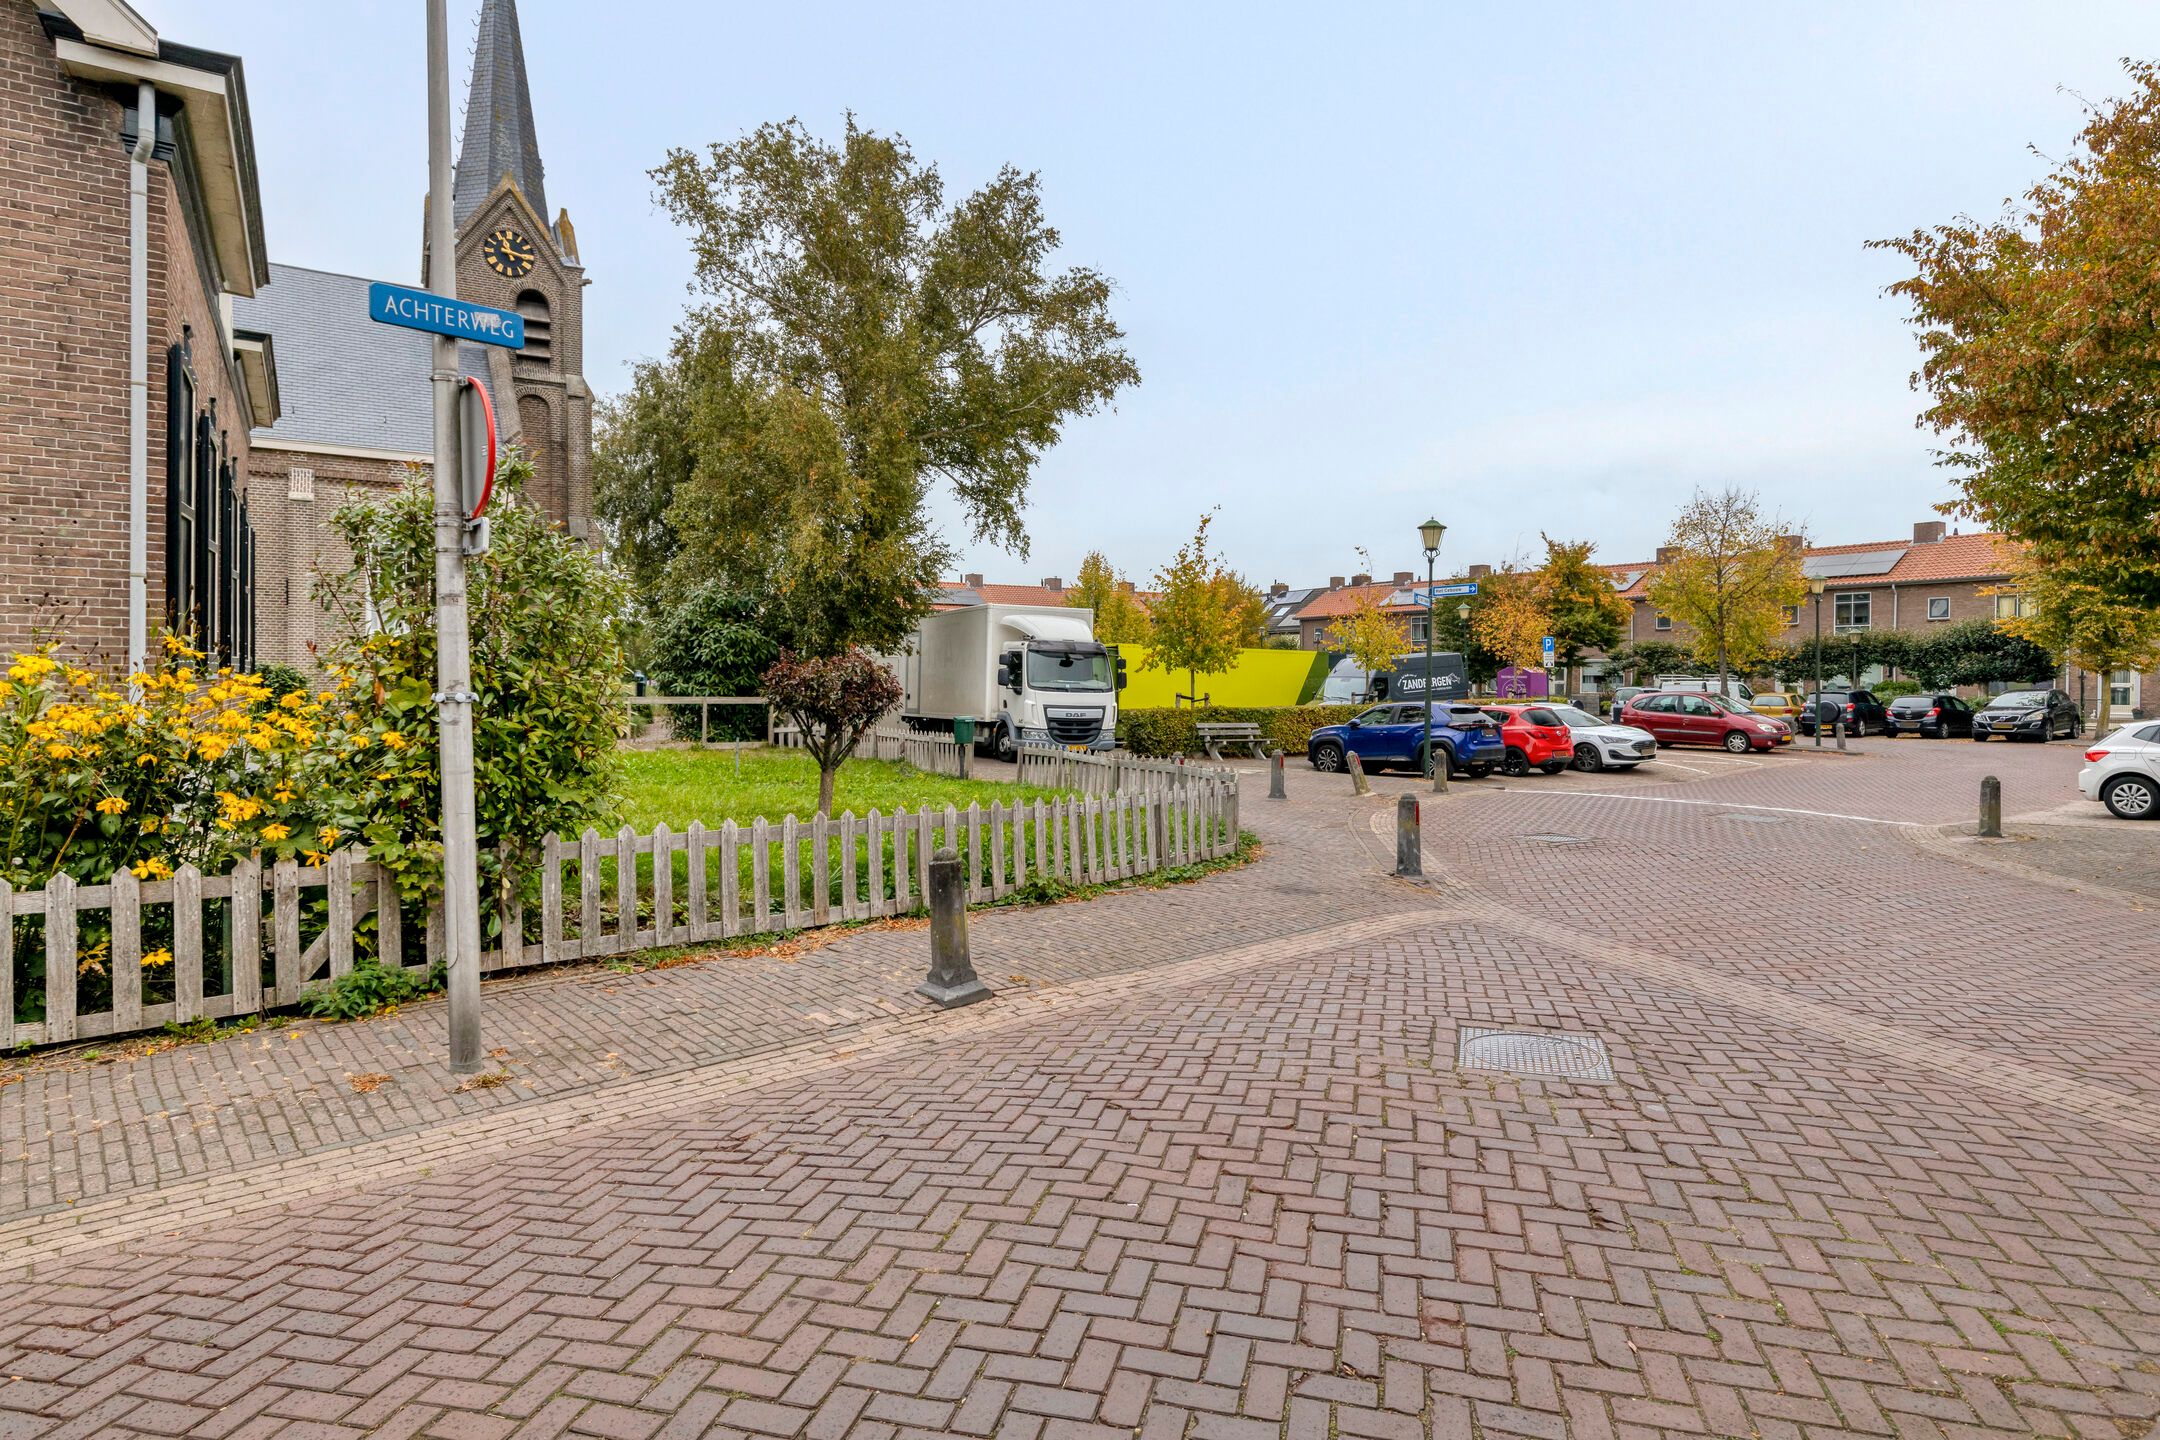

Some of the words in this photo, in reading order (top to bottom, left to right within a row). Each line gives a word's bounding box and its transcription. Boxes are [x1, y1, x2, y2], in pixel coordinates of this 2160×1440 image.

[384, 295, 514, 339] ACHTERWEG
[1546, 639, 1552, 650] P
[1402, 676, 1452, 690] ZANDRGEN
